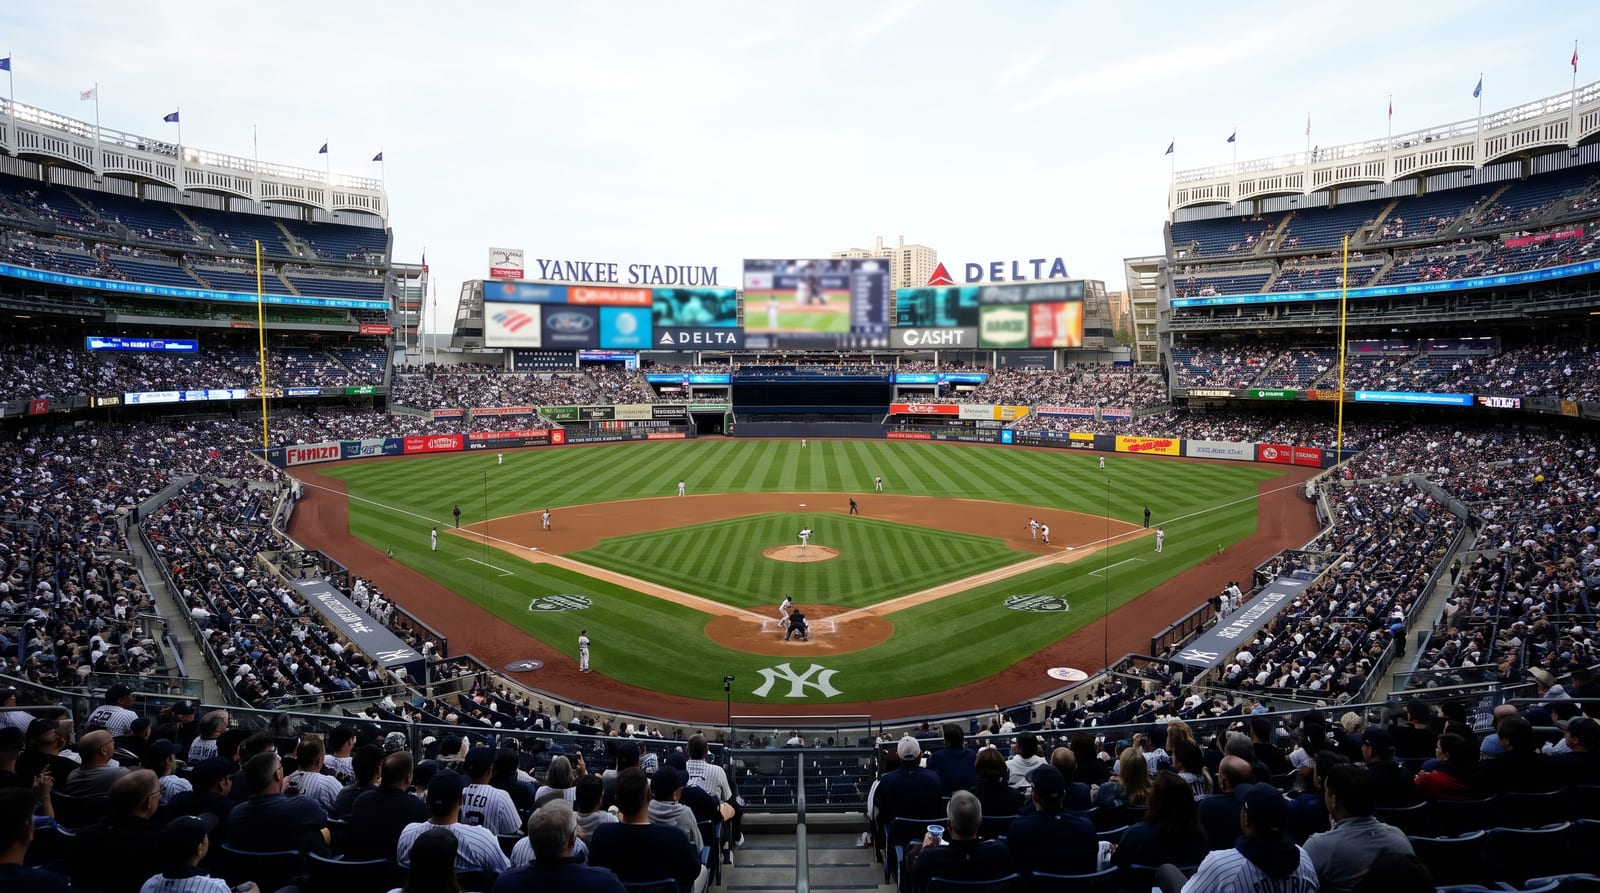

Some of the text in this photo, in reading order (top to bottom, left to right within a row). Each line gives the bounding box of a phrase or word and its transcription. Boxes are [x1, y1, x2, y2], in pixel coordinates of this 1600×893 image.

[536, 259, 720, 286] YANKEE STADIUM
[965, 257, 1068, 283] DELTA
[679, 331, 737, 344] DELTA
